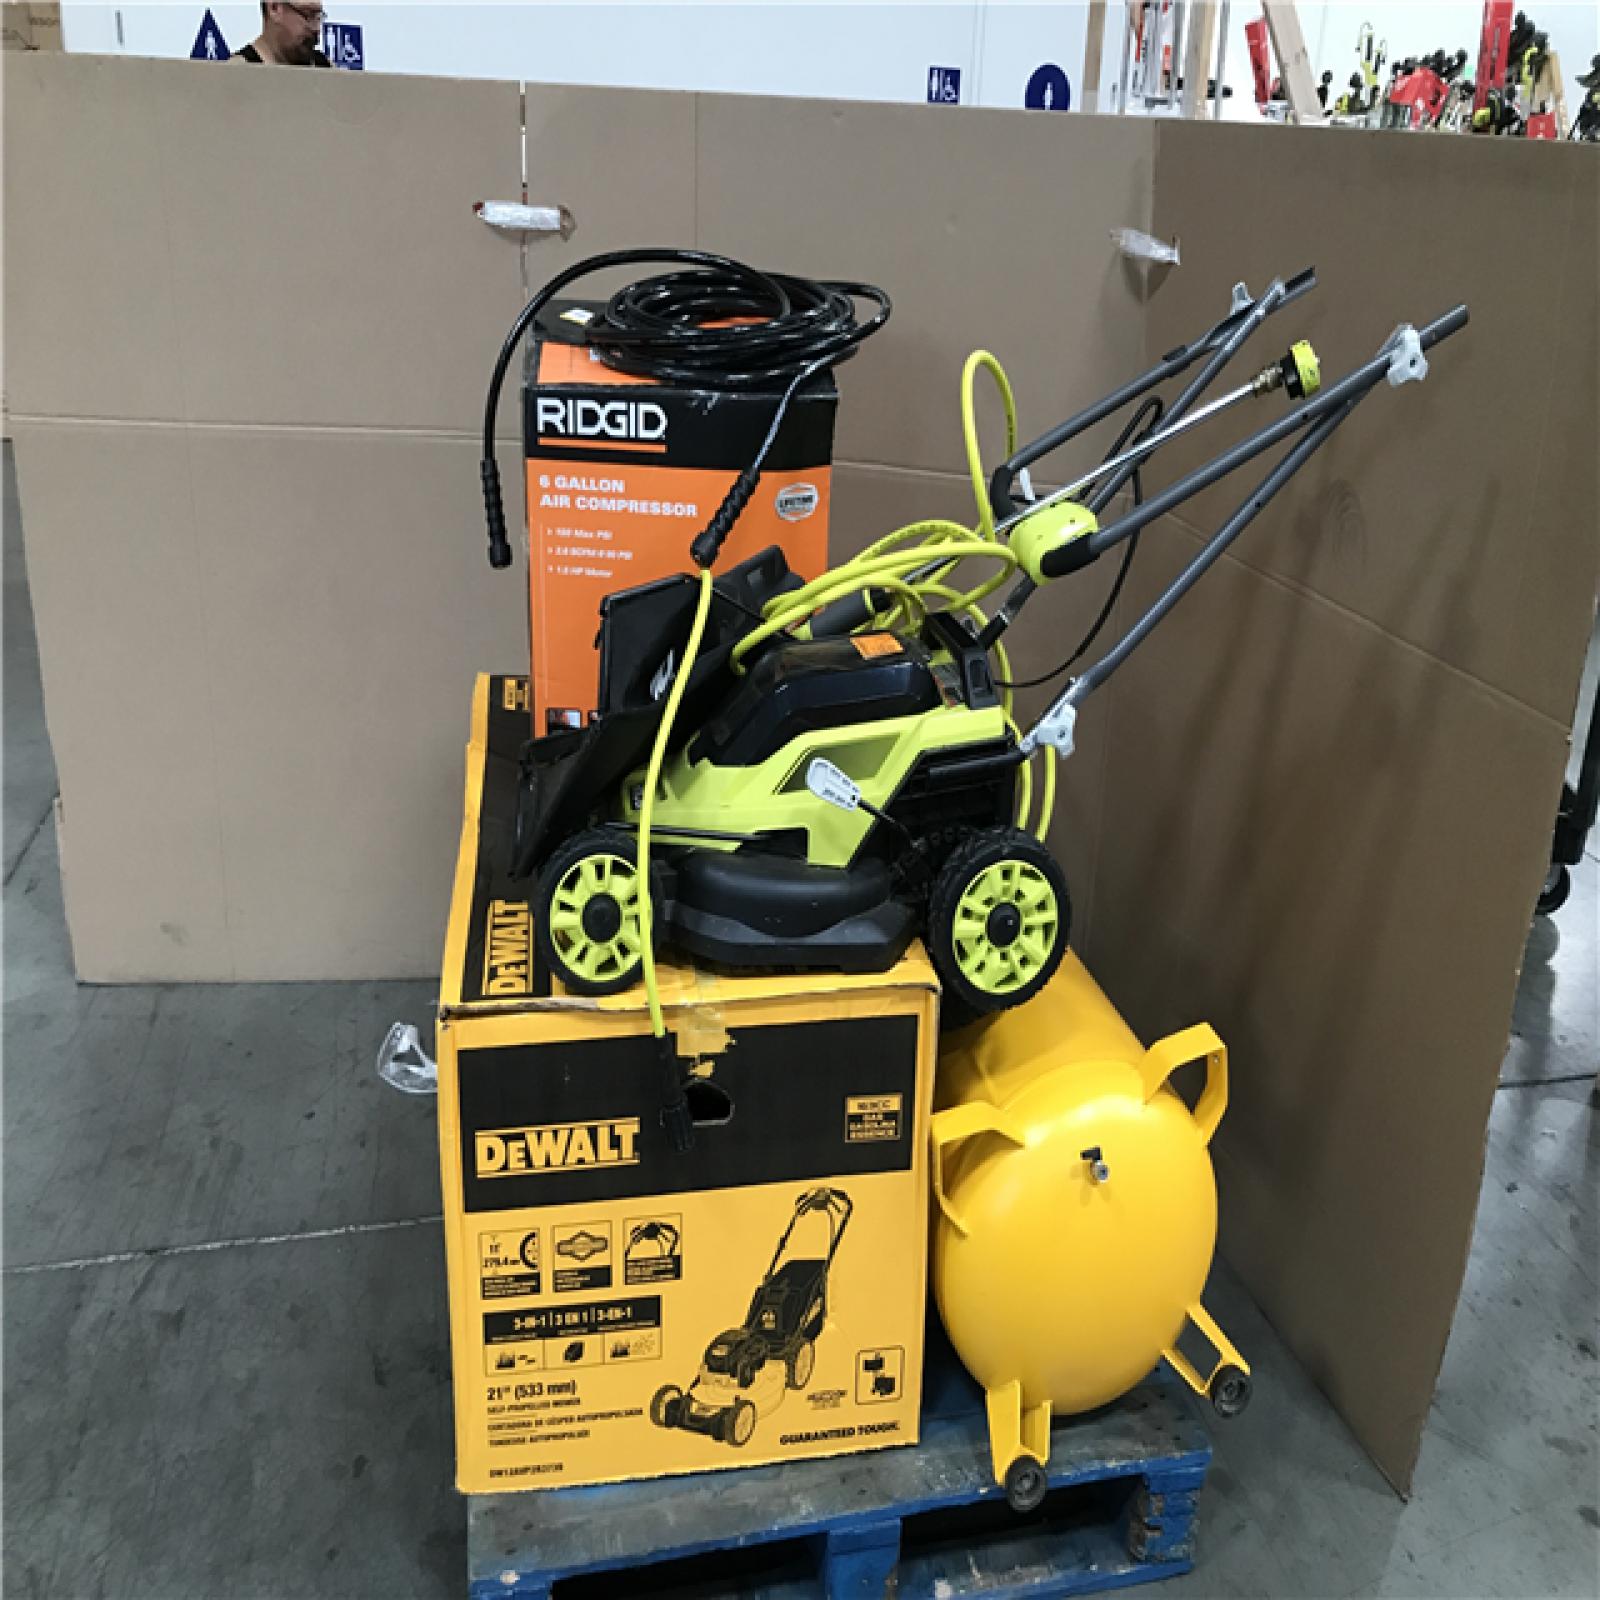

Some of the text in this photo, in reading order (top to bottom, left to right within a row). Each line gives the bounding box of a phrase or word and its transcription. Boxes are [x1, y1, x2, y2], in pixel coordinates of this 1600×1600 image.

[537, 397, 667, 440] RIDGID
[539, 474, 626, 493] 6 GALLON
[539, 494, 698, 517] AIR COMPRESSOR
[488, 899, 530, 994] DEWALT
[476, 1121, 640, 1173] DEWALT
[547, 1379, 576, 1396] mm)
[779, 1426, 856, 1446] GUARANTEED
